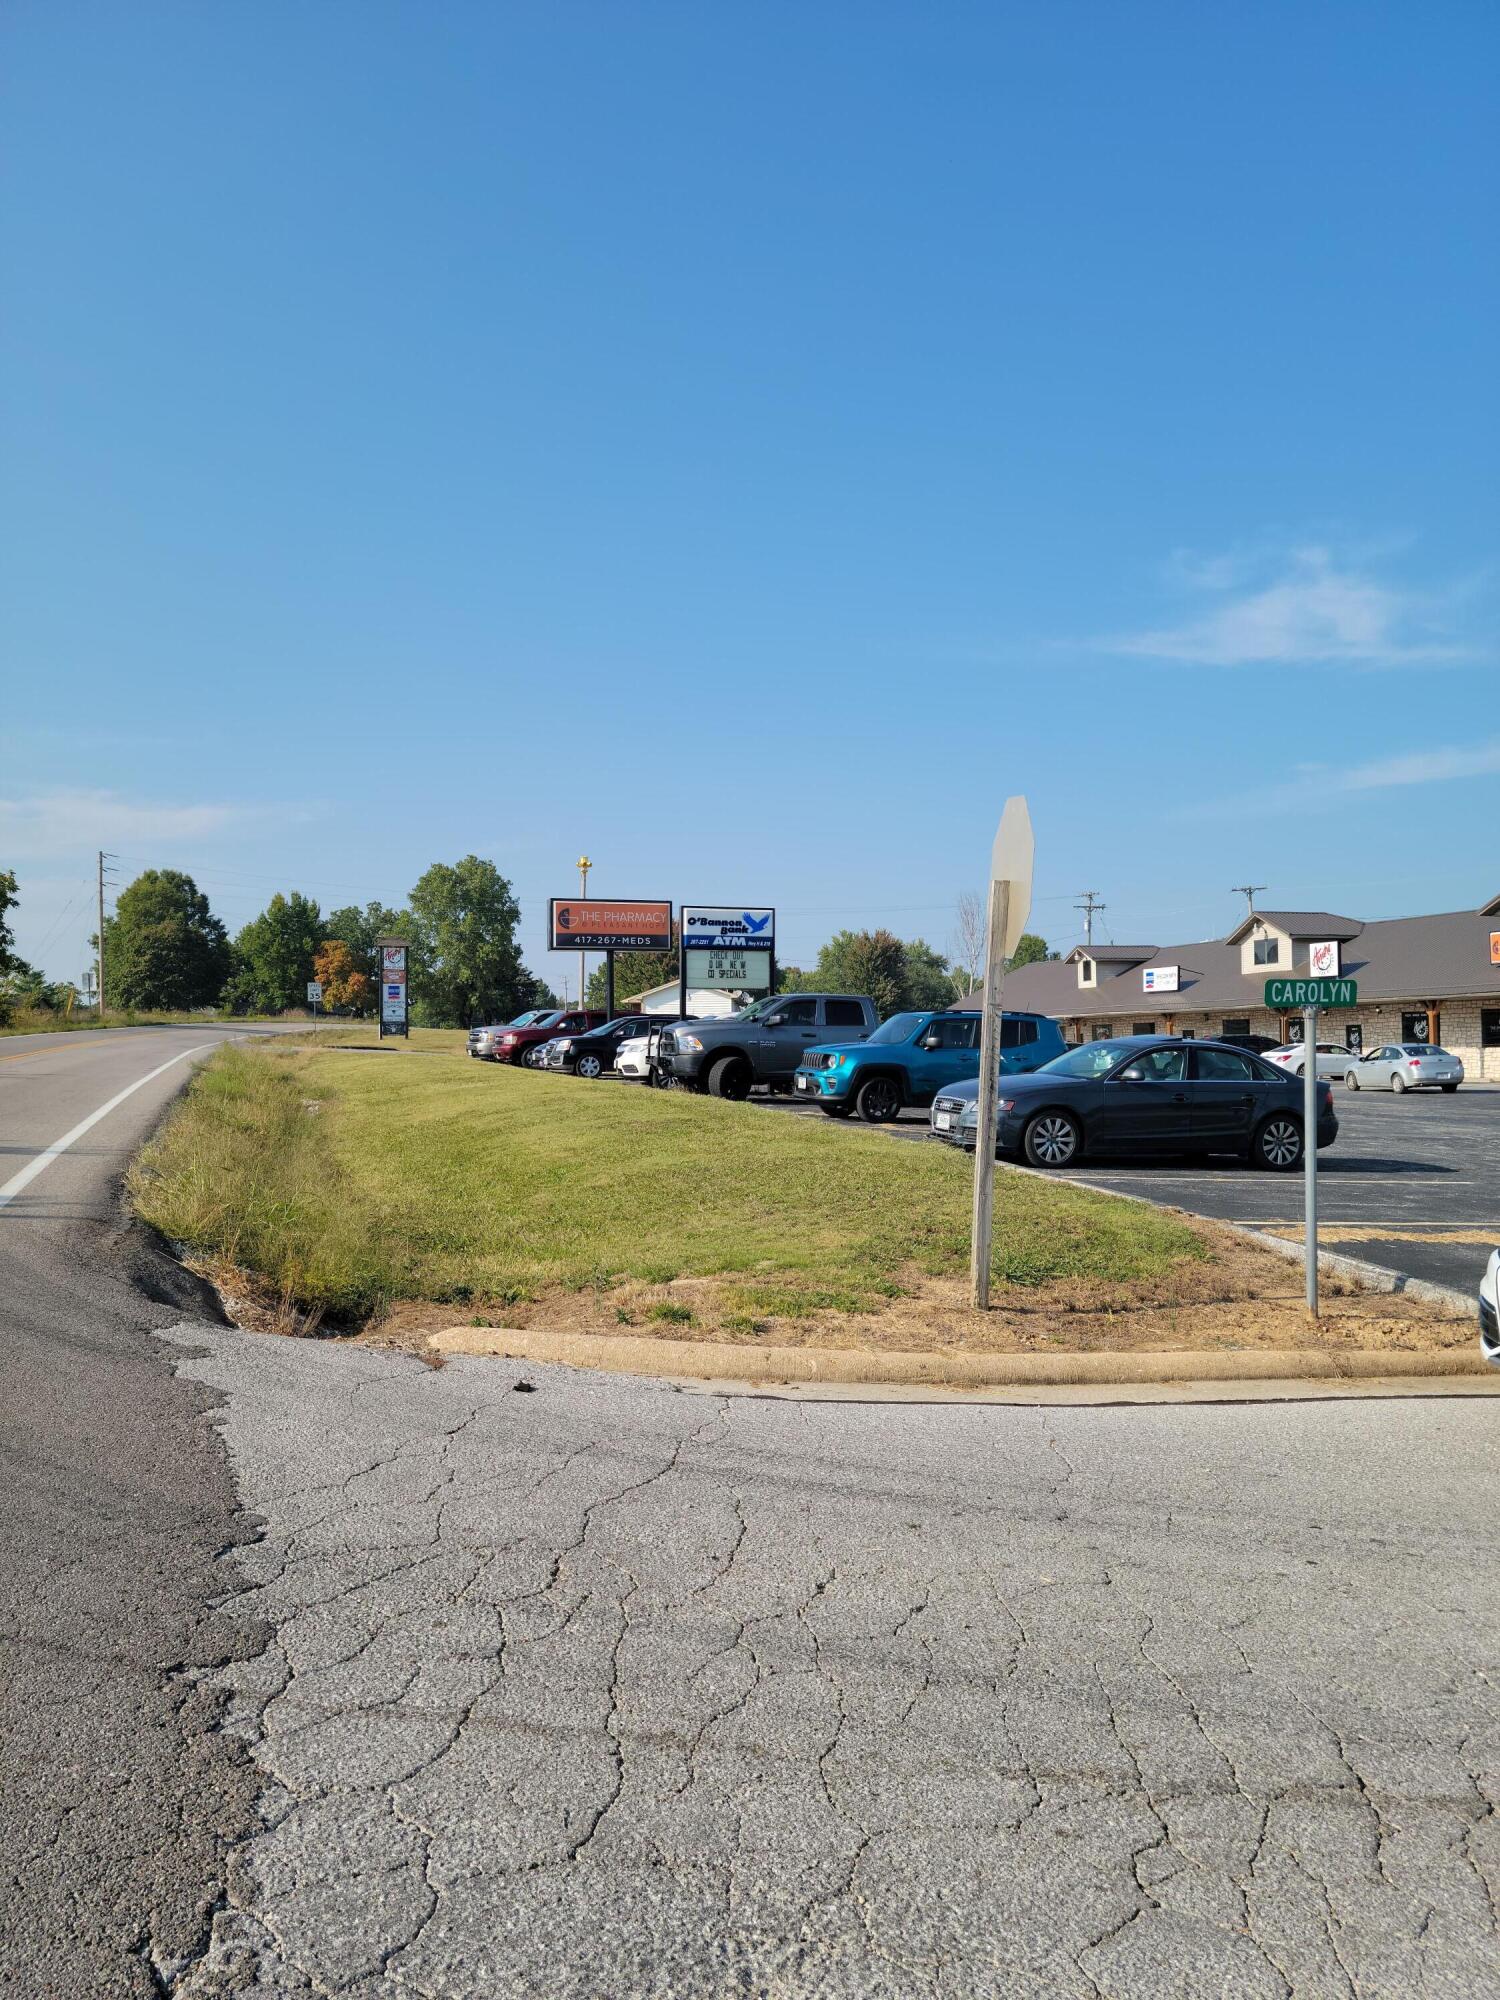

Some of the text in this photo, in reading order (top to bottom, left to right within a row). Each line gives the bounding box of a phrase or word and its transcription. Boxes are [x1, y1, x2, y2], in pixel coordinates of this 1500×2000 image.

[582, 911, 666, 923] THE PHARMACY
[687, 917, 742, 926] O'Bannon
[720, 925, 749, 935] Bank
[575, 936, 651, 945] 417-267-MEDS
[712, 937, 746, 946] ATM
[709, 951, 744, 960] CHECK OUT
[718, 970, 747, 979] SPECIALS
[1271, 982, 1351, 1003] CAROLYN
